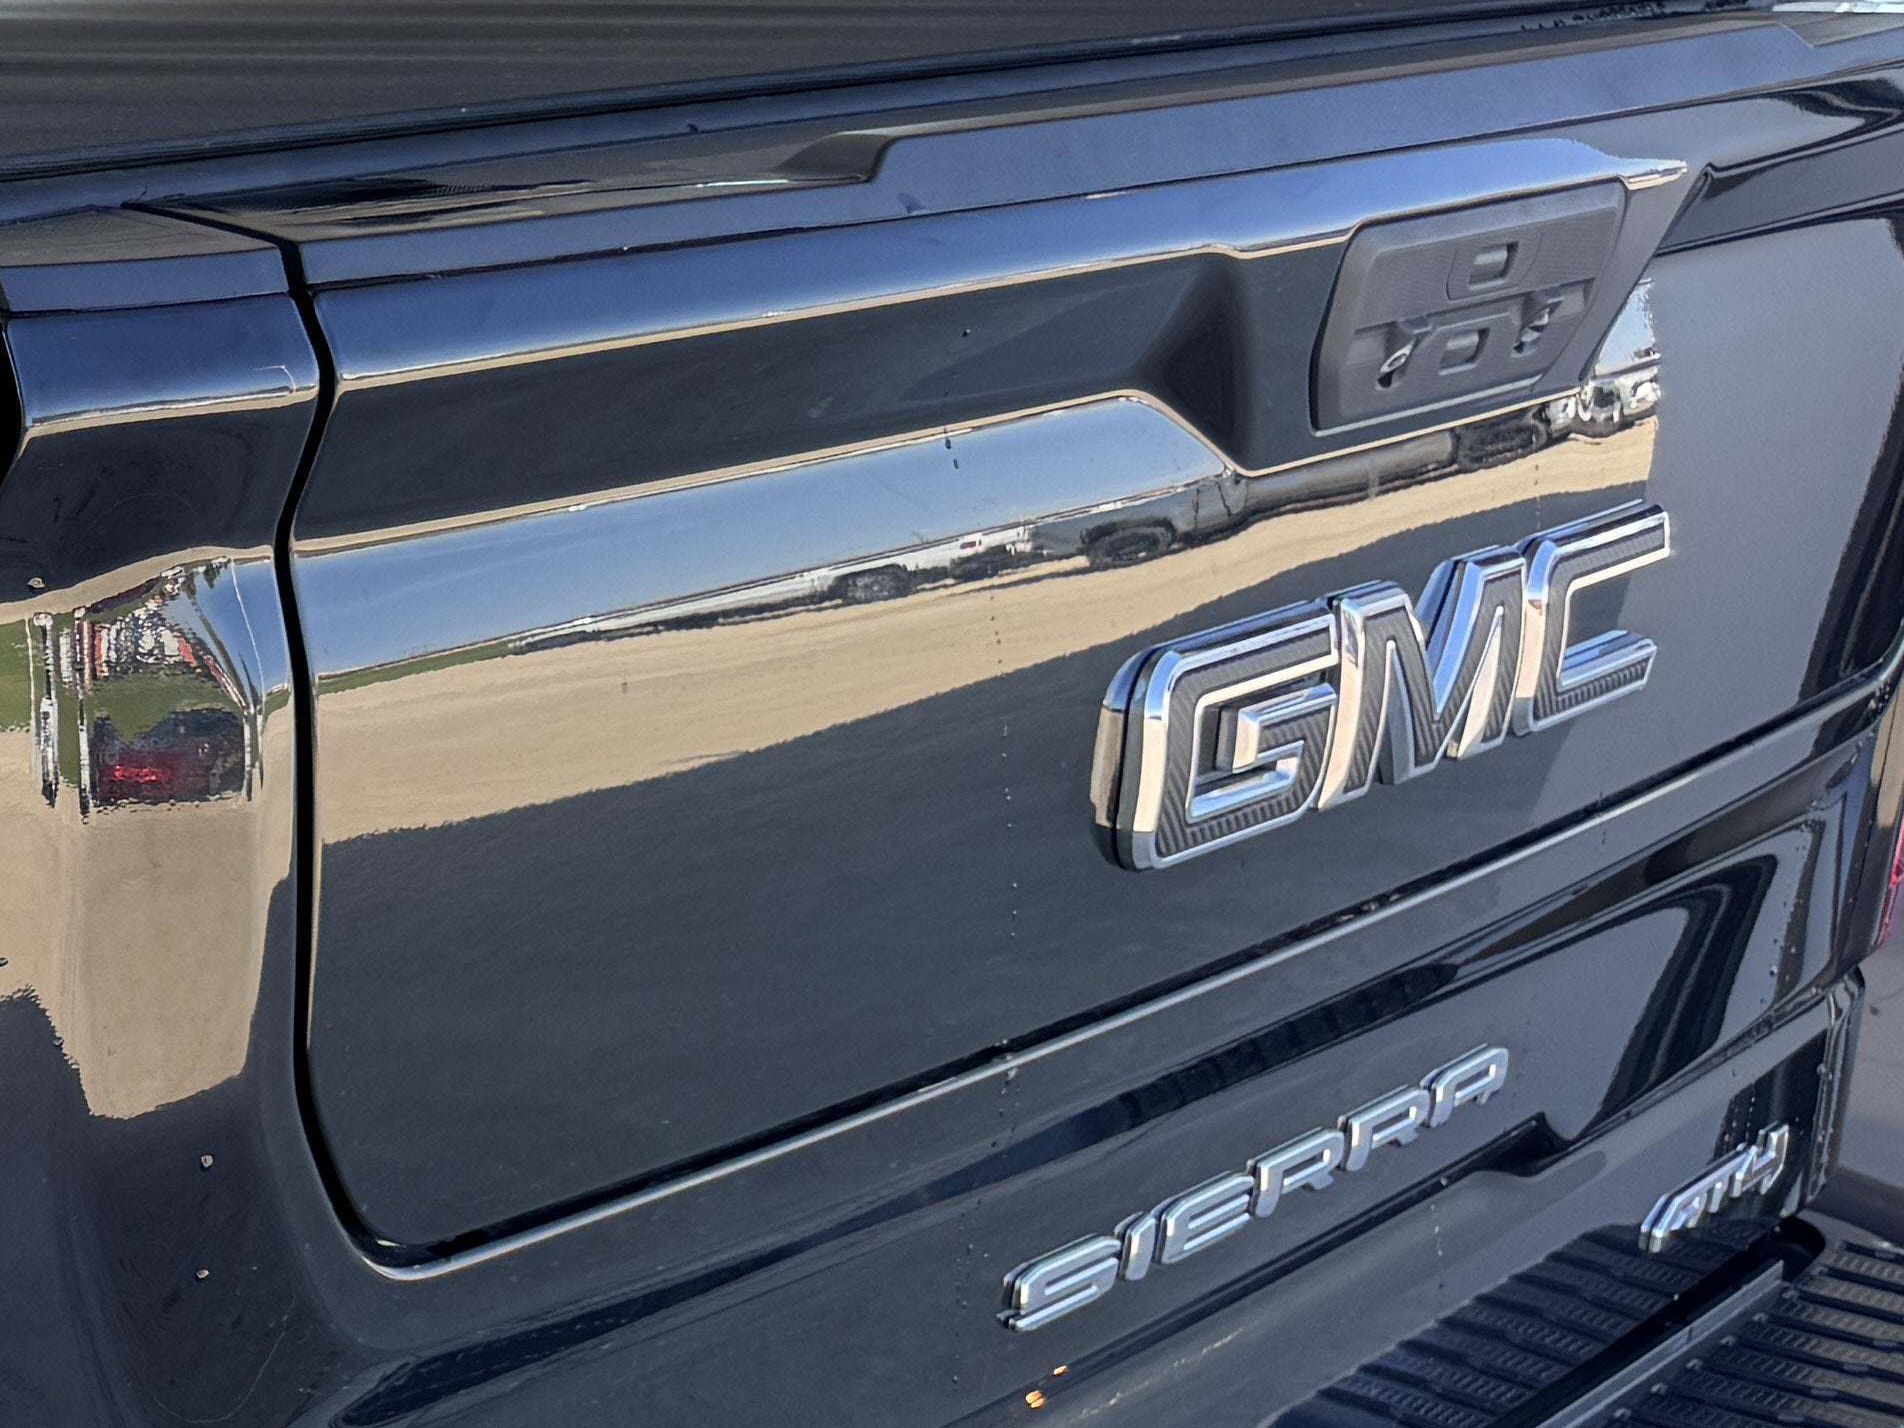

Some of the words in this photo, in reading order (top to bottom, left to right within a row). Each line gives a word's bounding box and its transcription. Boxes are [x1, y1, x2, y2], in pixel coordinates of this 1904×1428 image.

[1090, 499, 1670, 870] GMC
[997, 1044, 1508, 1332] SIERRA
[1638, 1122, 1789, 1253] AT4
